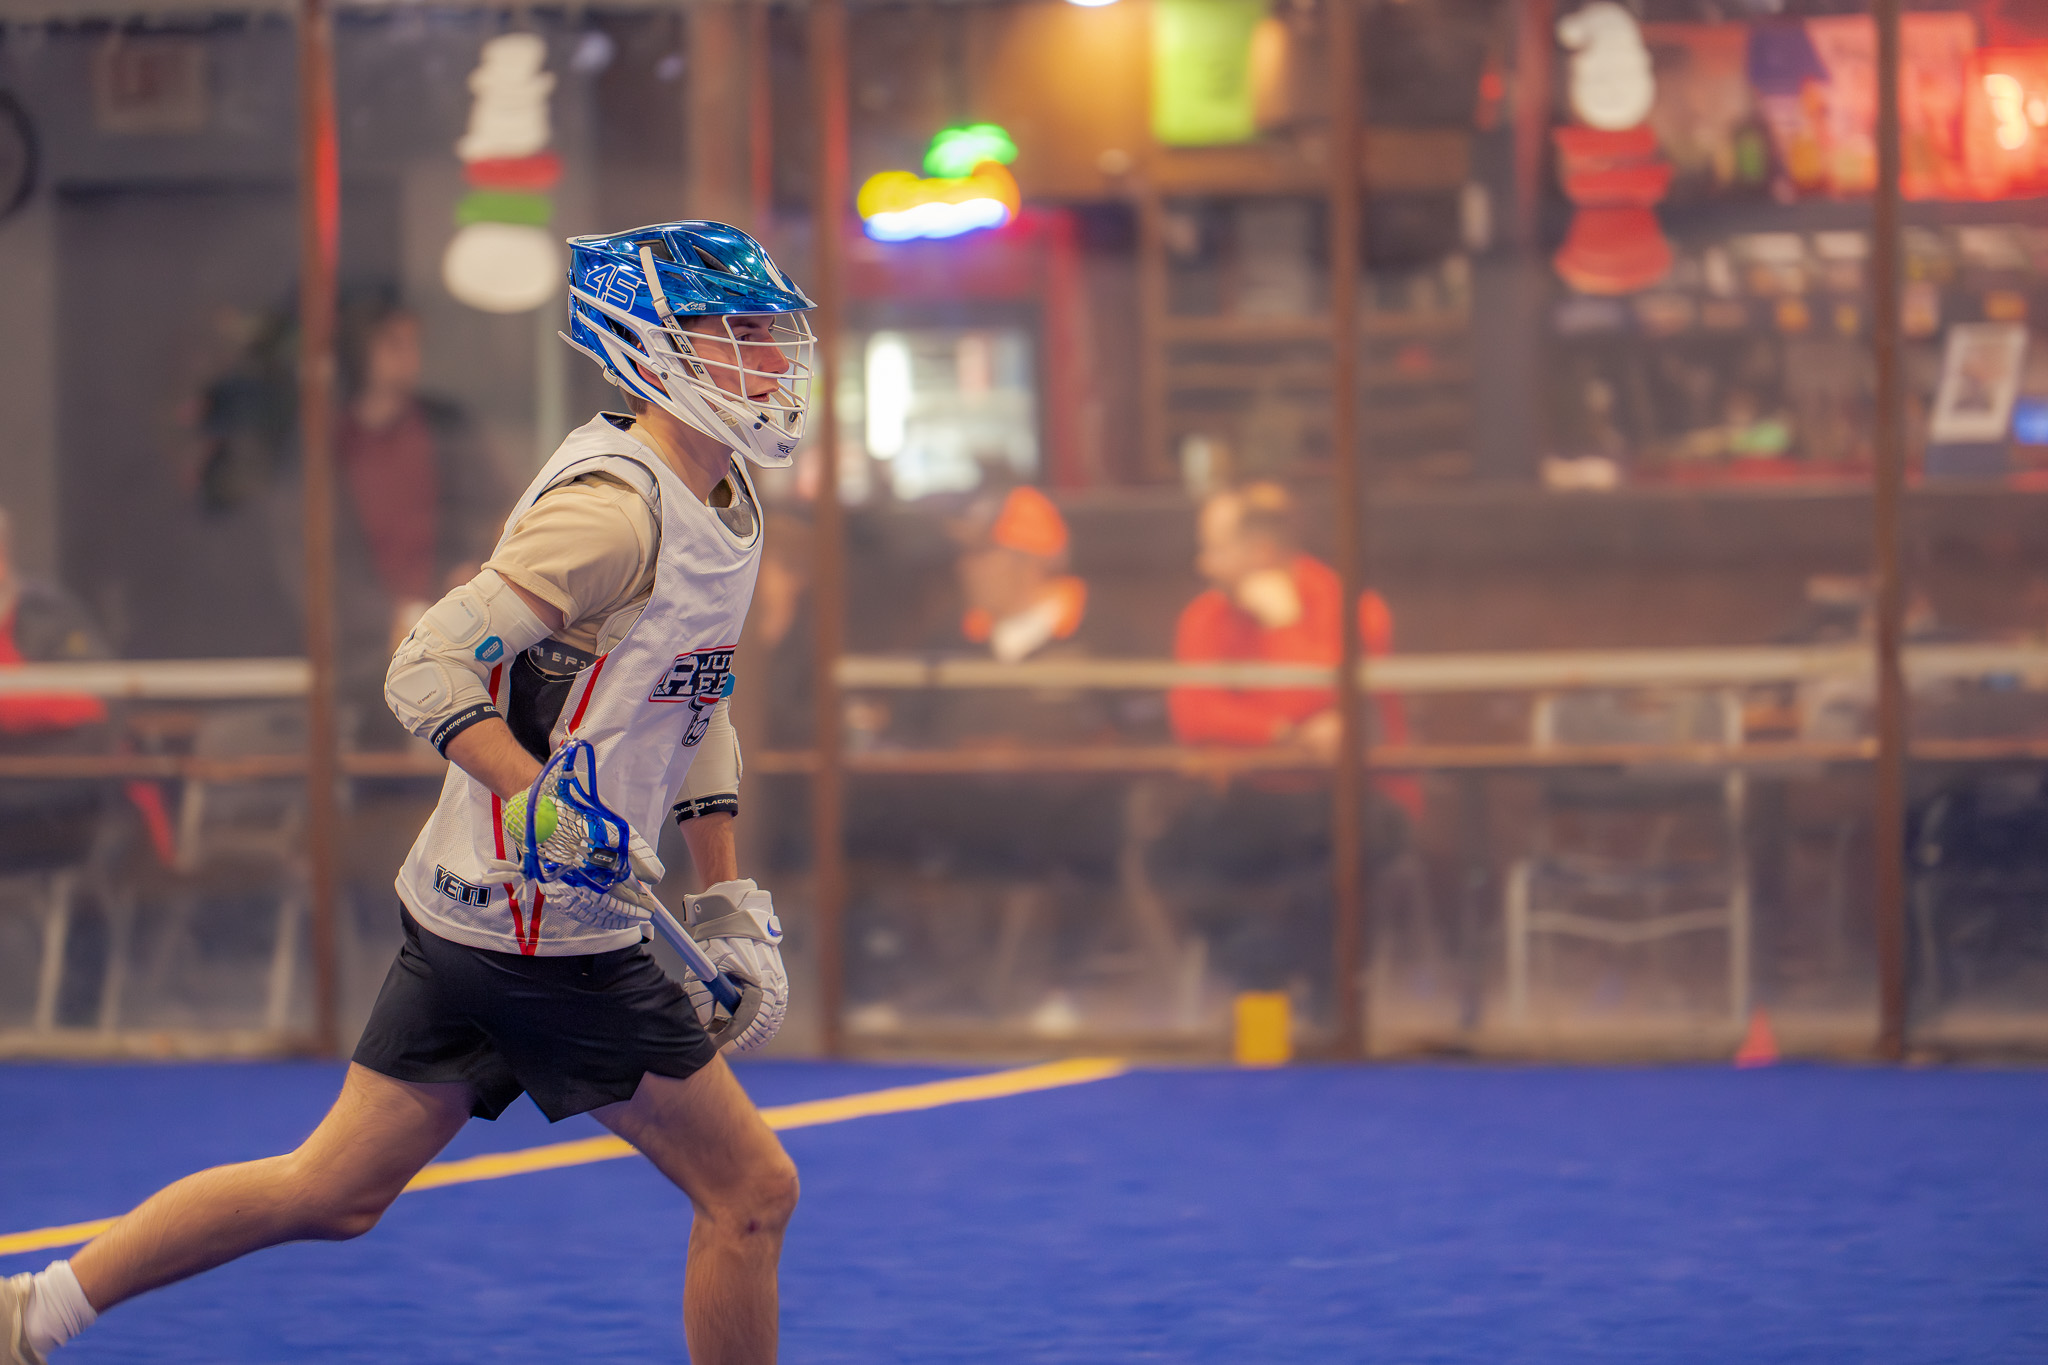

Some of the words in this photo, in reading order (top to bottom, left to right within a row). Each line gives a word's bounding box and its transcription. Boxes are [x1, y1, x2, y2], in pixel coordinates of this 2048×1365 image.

[584, 263, 641, 312] 45
[442, 710, 477, 736] LACROSSE
[433, 864, 491, 908] YETI
